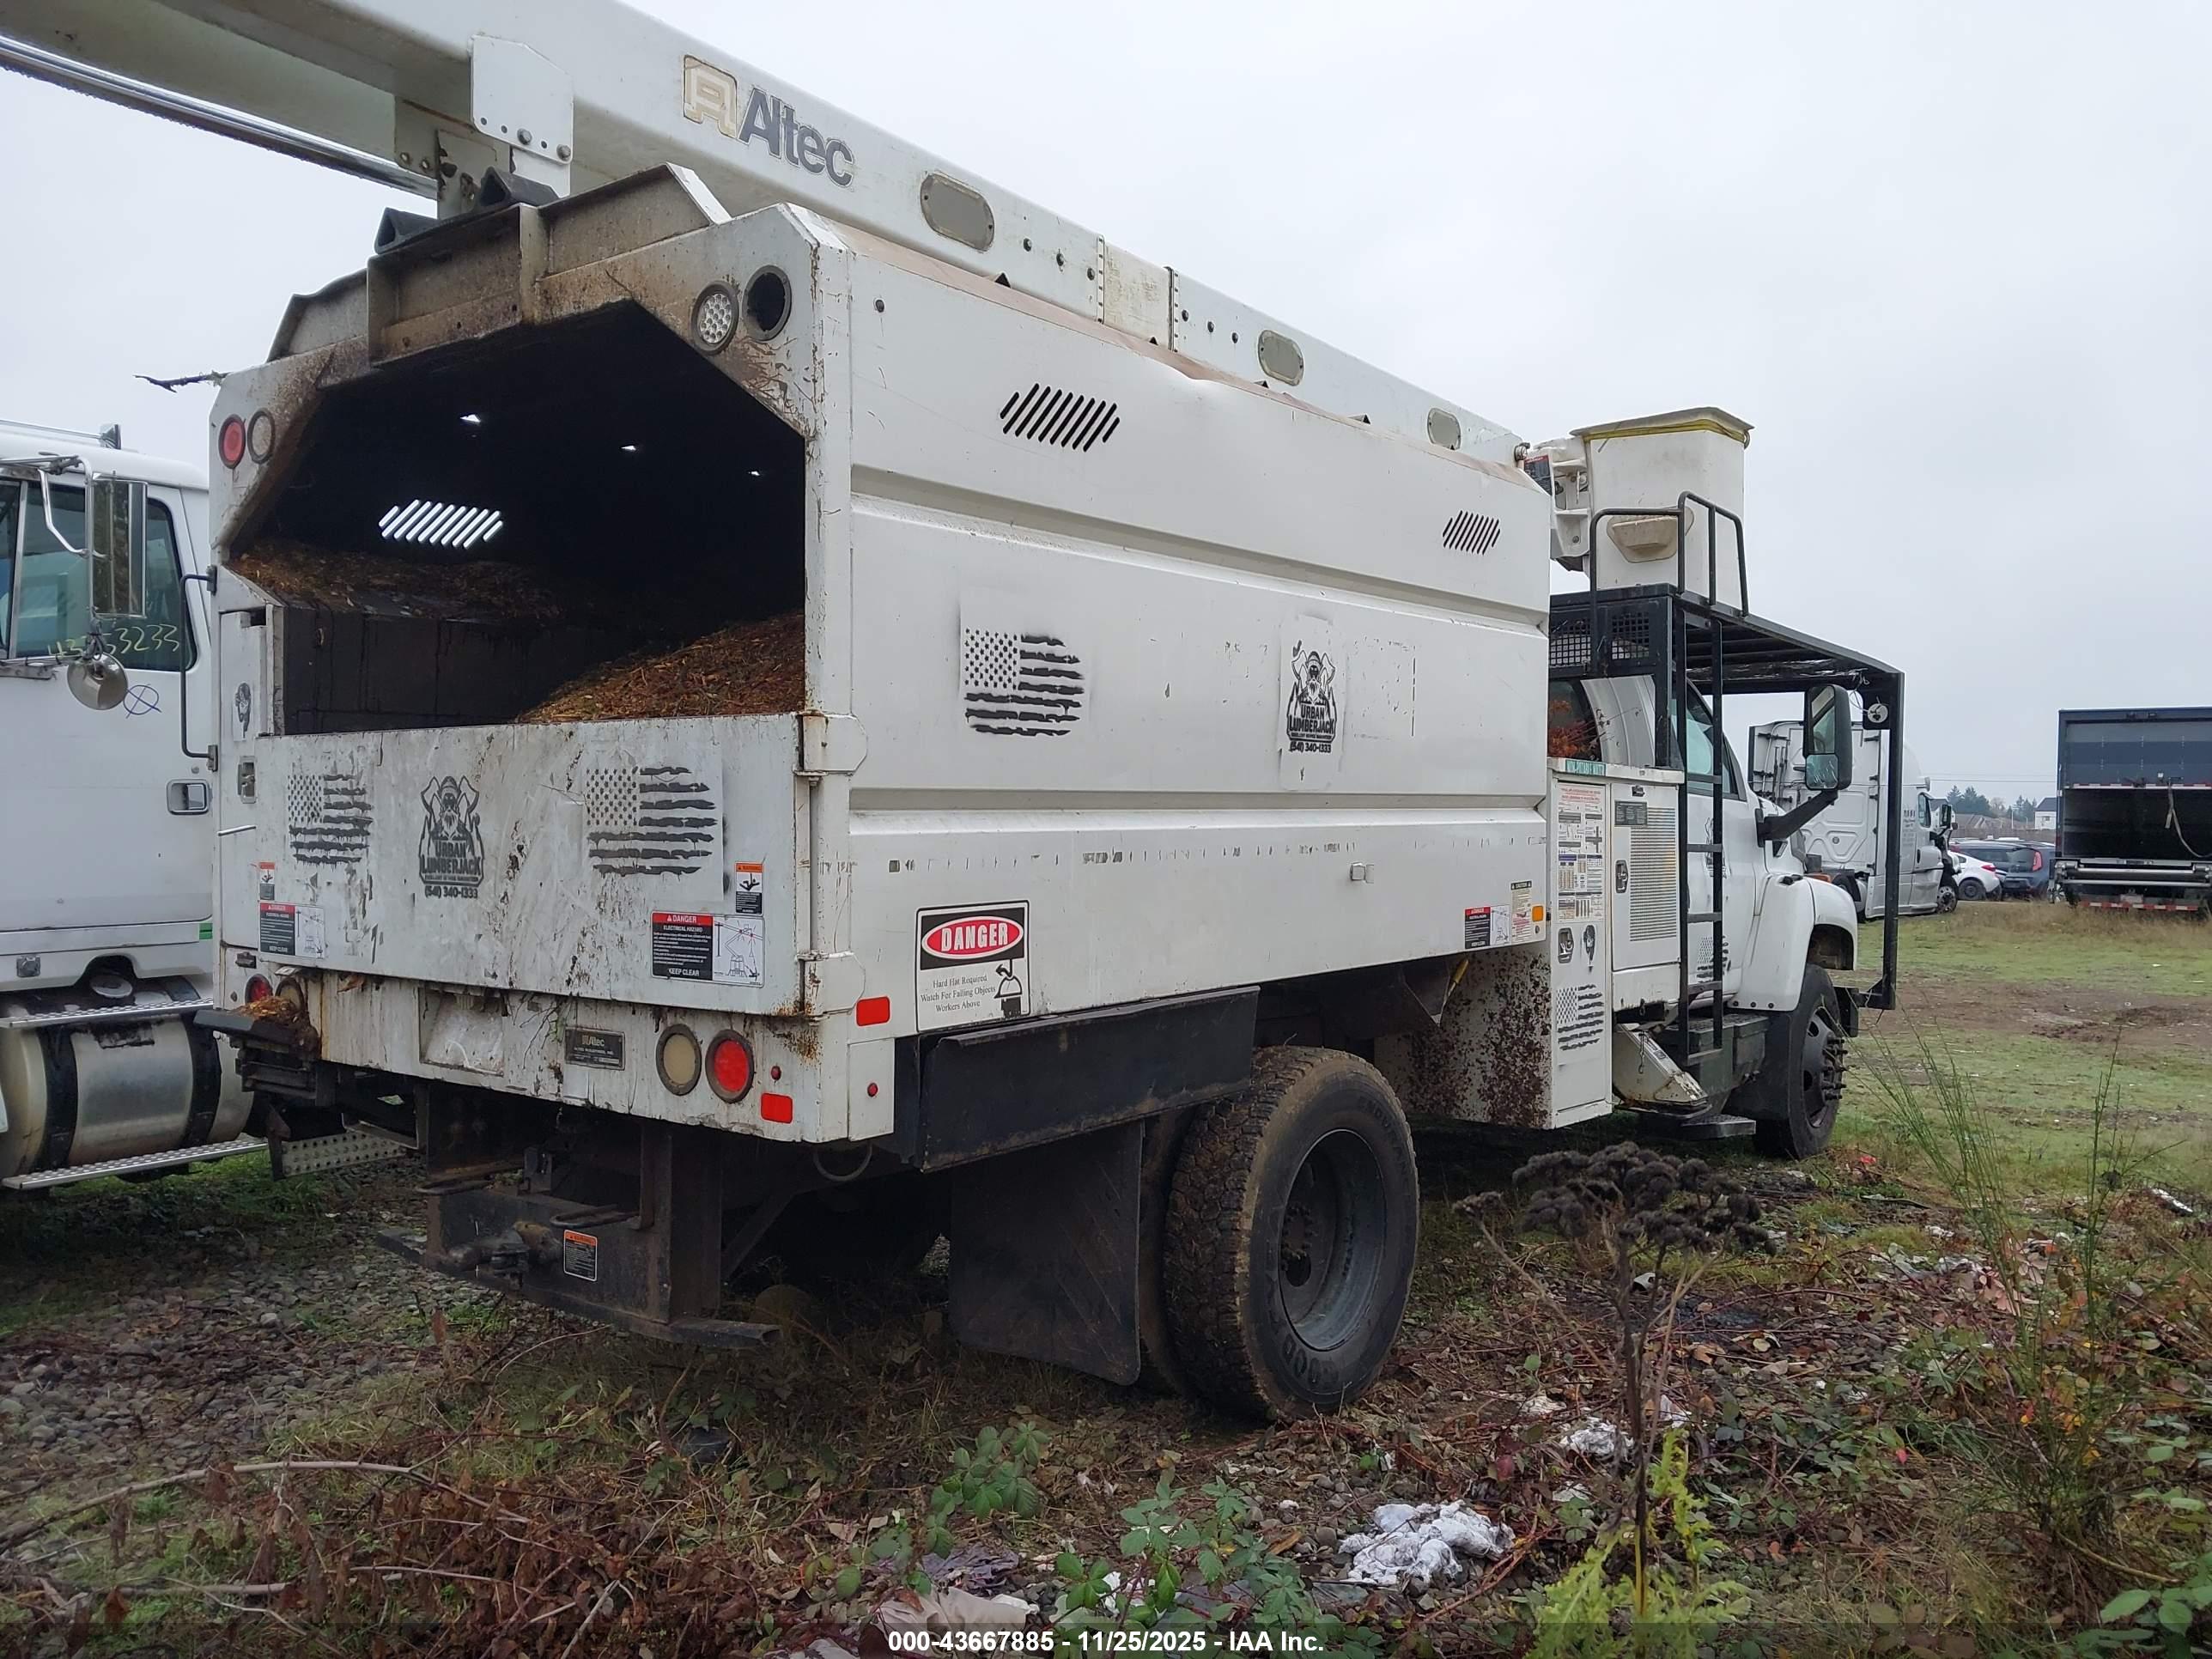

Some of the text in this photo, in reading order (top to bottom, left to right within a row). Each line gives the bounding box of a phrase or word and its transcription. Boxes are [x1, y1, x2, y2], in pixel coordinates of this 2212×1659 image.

[737, 87, 854, 187] Altec
[1300, 704, 1325, 720] URBAN
[1289, 715, 1334, 734] LUMBERJACK
[435, 840, 466, 858] URBAN
[421, 854, 481, 875] LUMBERJACK
[672, 915, 697, 924] DANGER
[941, 922, 1008, 952] DANGER
[933, 975, 988, 988] Hard Hat Required
[921, 993, 939, 1002] Watch
[952, 989, 973, 999] Falling
[974, 986, 996, 996] Objects
[935, 1000, 981, 1012] Workers Above
